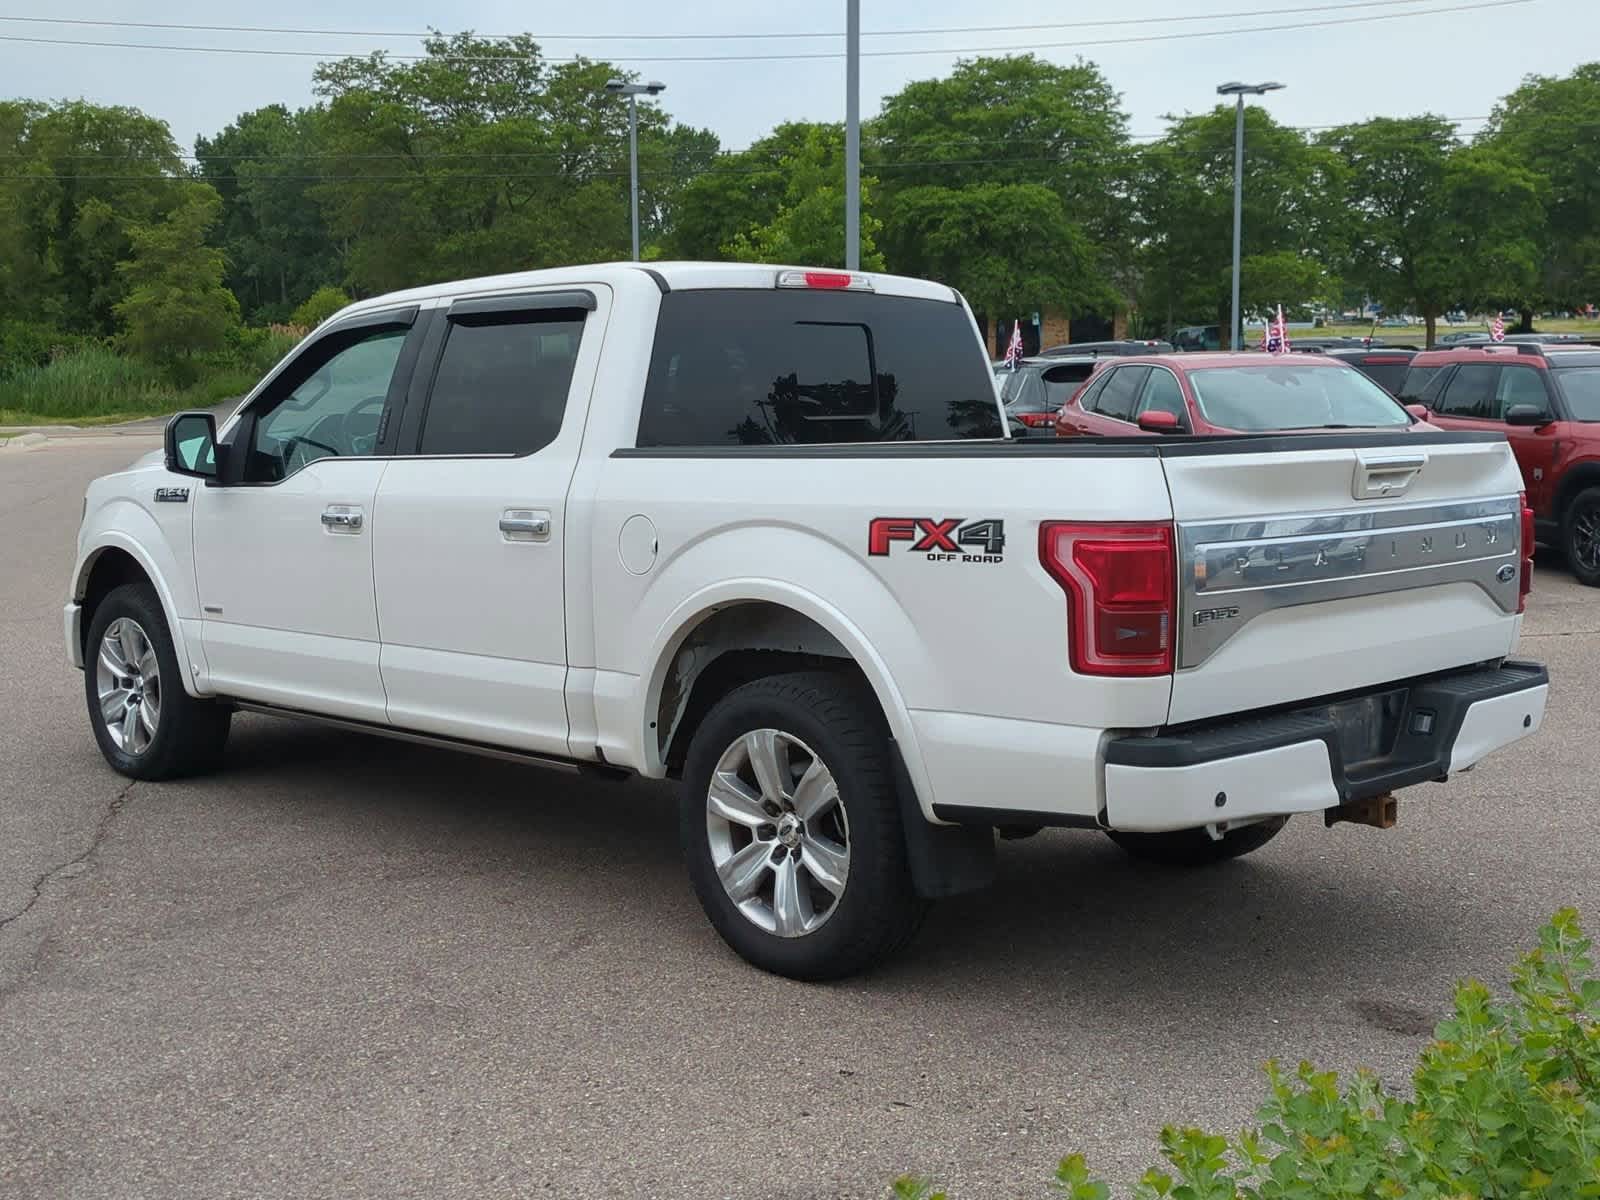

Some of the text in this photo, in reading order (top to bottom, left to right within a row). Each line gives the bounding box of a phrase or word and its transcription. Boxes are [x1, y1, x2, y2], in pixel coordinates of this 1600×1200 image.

[868, 517, 1005, 557] FX4
[1233, 525, 1499, 575] PLATINUM
[927, 553, 1003, 563] OFF ROAD
